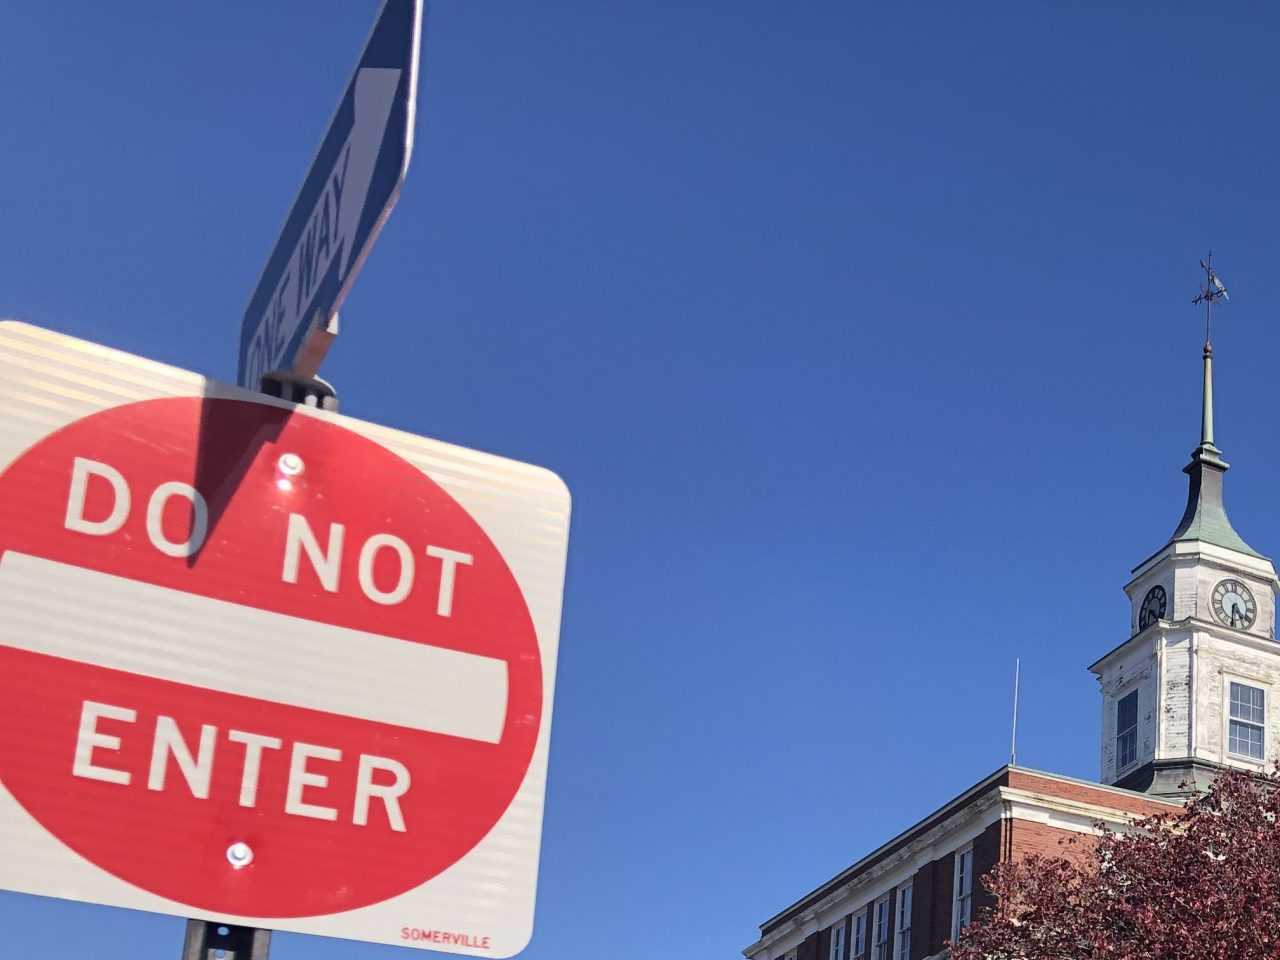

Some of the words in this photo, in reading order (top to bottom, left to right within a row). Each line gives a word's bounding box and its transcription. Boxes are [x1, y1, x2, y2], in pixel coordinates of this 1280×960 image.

[297, 143, 352, 318] WAY
[64, 456, 209, 558] DO
[281, 512, 473, 618] NOT
[72, 700, 411, 832] ENTER
[401, 927, 491, 949] SOMERVILLE
